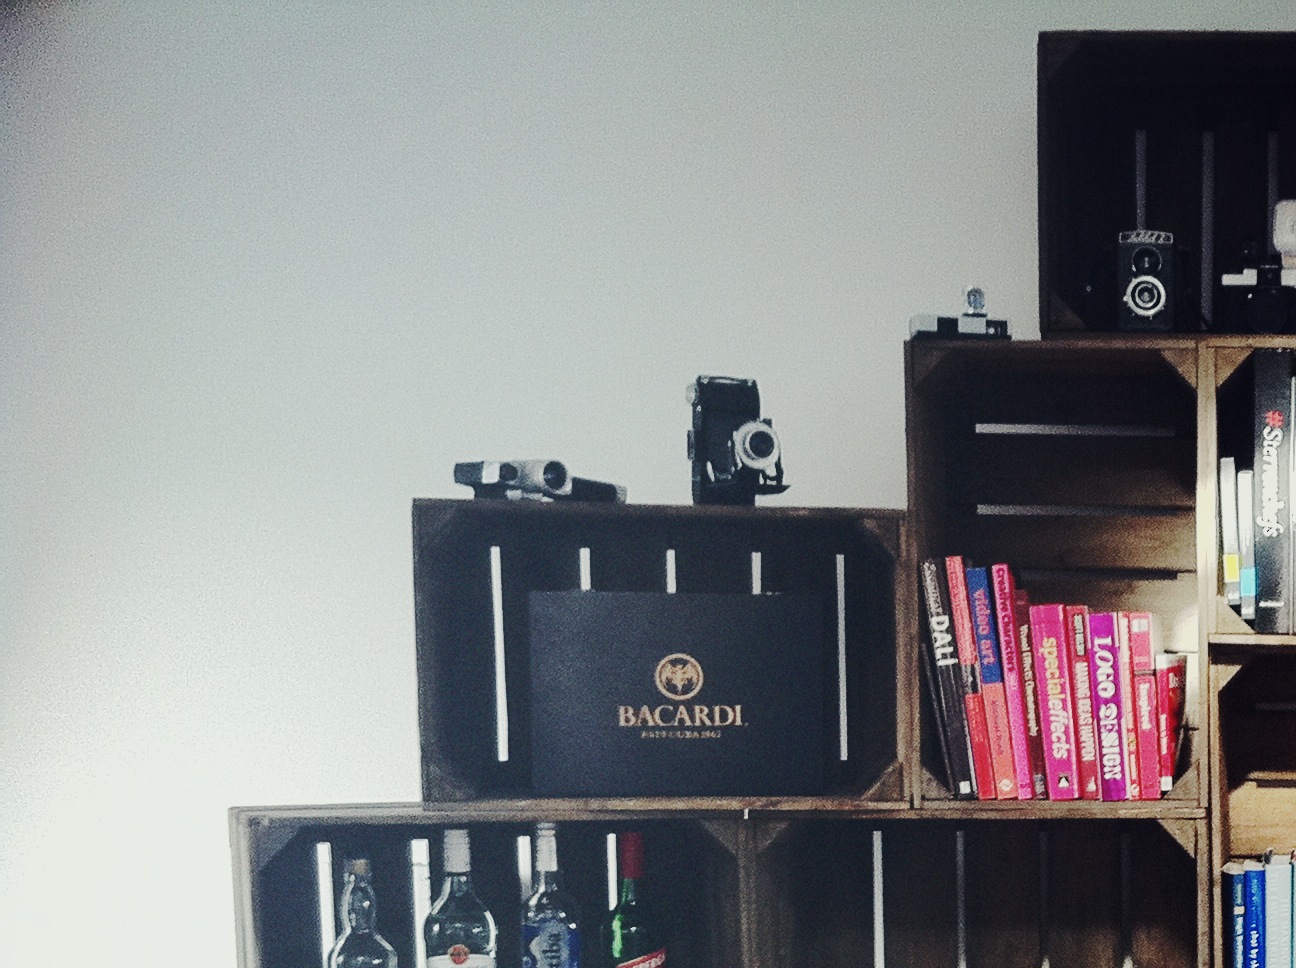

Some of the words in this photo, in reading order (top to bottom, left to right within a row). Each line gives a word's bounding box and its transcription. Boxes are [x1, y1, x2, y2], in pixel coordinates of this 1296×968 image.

[973, 589, 989, 634] video
[981, 640, 996, 666] art
[1075, 662, 1091, 698] MAKING
[1093, 636, 1116, 699] LOGO
[618, 704, 743, 727] BACARDI
[1078, 699, 1093, 725] IDEAS
[1079, 726, 1095, 761] HAPPEN
[1099, 703, 1122, 780] DESIGN
